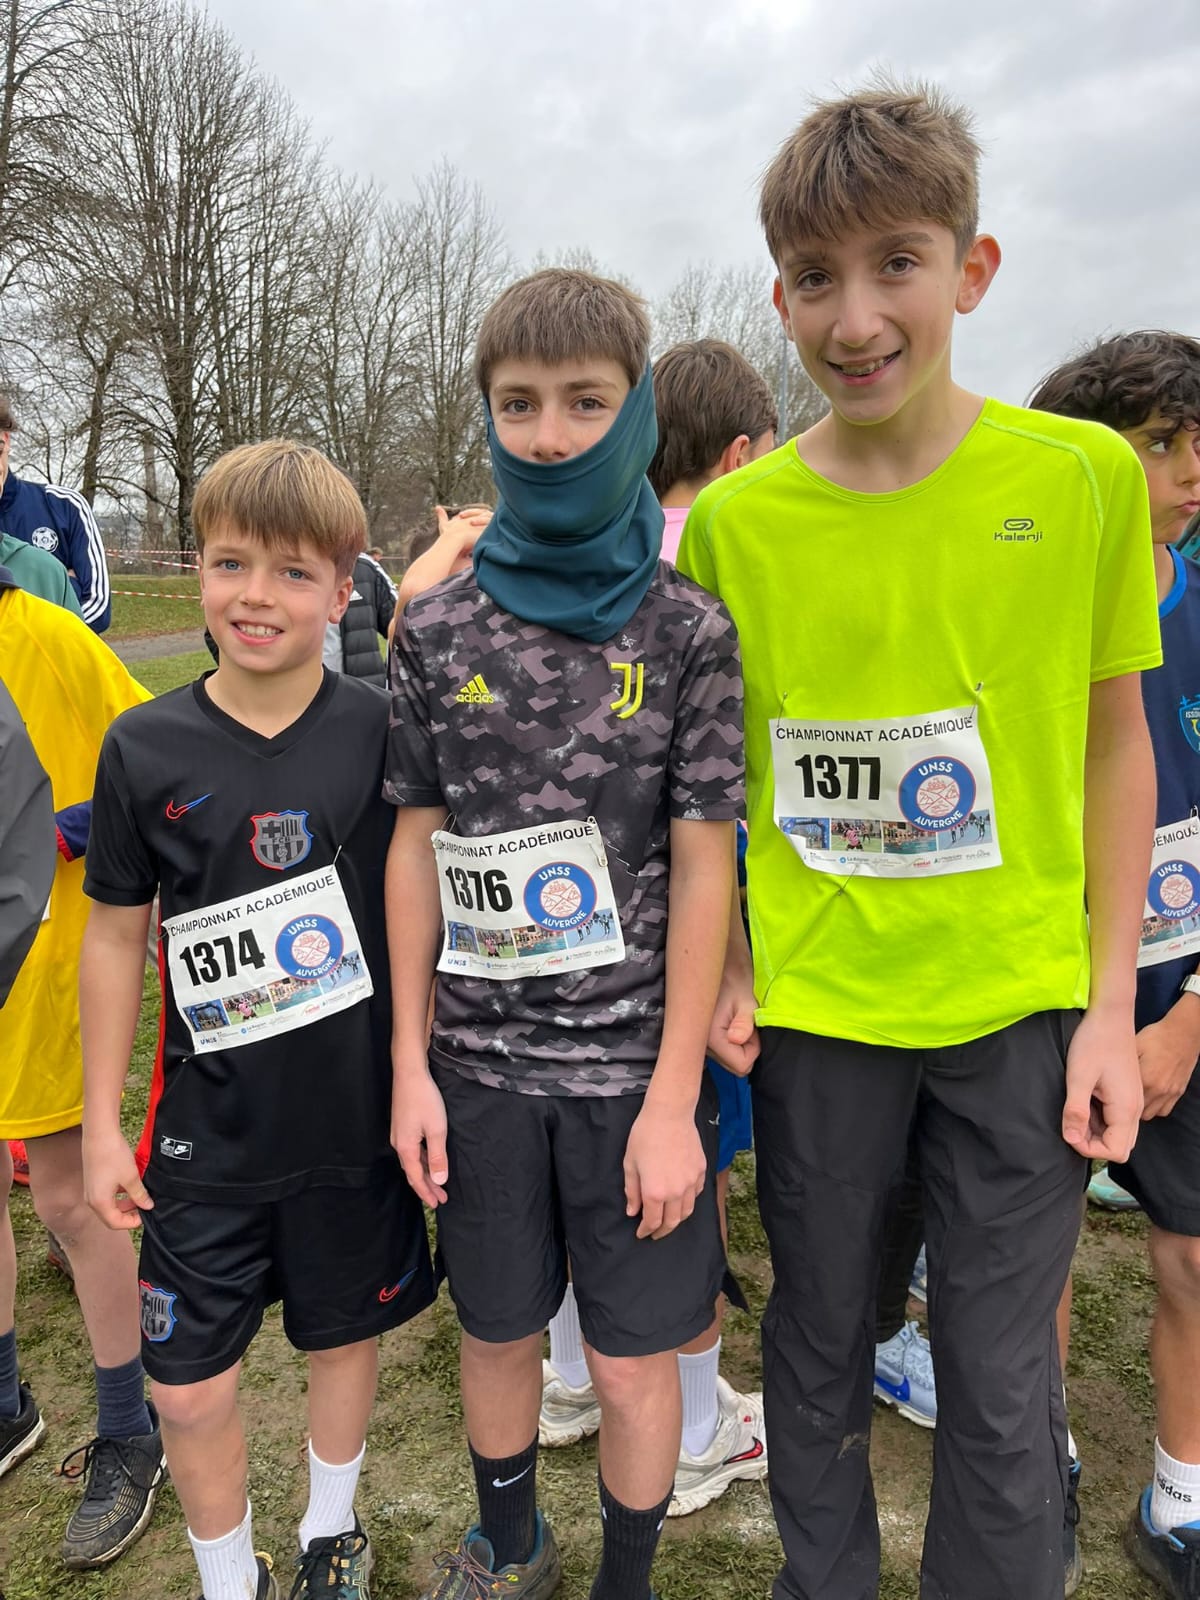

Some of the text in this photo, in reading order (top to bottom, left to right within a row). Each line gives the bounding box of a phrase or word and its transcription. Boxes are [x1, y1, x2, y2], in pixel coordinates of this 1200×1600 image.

[455, 693, 495, 703] adidas
[776, 716, 974, 743] CHAMPIONNAT ACADÉMIQUE
[794, 753, 881, 801] 1377
[918, 761, 954, 776] UNSS
[914, 810, 963, 829] AUVERGNE
[498, 825, 594, 855] ACADÉMIQUE
[538, 866, 571, 881] UNSS
[1157, 863, 1183, 878] UNSS
[445, 865, 513, 913] 1376
[170, 874, 336, 937] CHAMPIONNAT ACADÉMIQUE
[1162, 901, 1199, 917] AUVERGNE
[287, 918, 318, 936] UNSS
[541, 910, 588, 929] AUVERGNE
[179, 928, 266, 987] 1374
[295, 956, 336, 976] AUVERGNE
